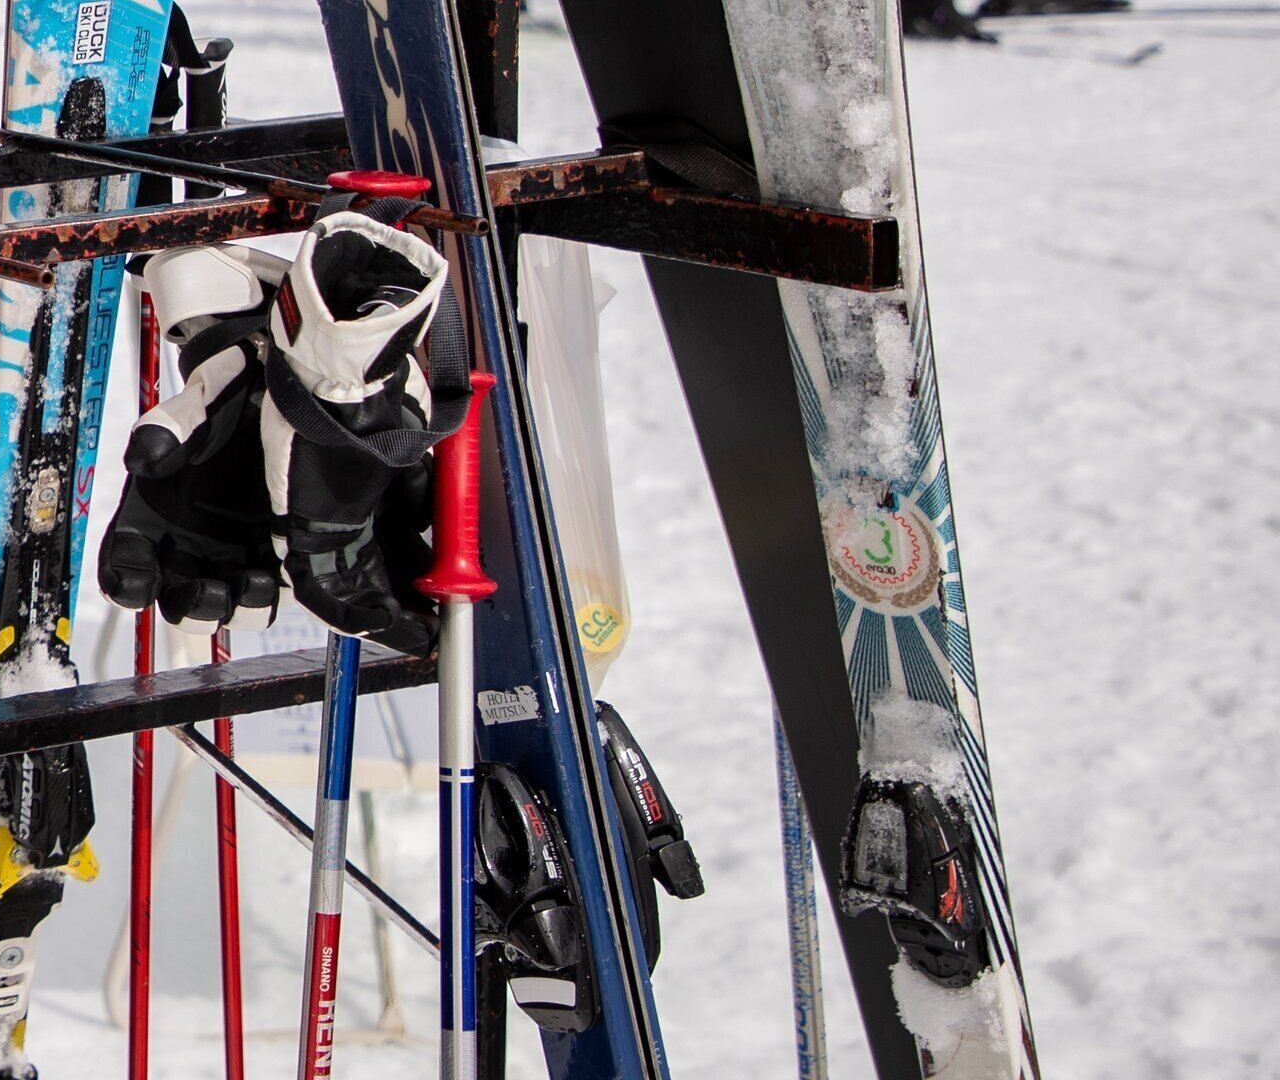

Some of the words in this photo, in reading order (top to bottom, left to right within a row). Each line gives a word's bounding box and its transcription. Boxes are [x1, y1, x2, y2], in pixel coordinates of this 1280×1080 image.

[80, 6, 93, 26] SKI
[88, 4, 107, 59] DUCK
[75, 29, 90, 61] CLUB
[127, 26, 143, 102] ROCKER
[73, 465, 95, 520] SX
[592, 621, 619, 647] Lemon
[487, 691, 520, 706] HOTE
[17, 752, 37, 842] ATOMIC
[319, 946, 333, 993] SINANO
[314, 1000, 336, 1080] REN
